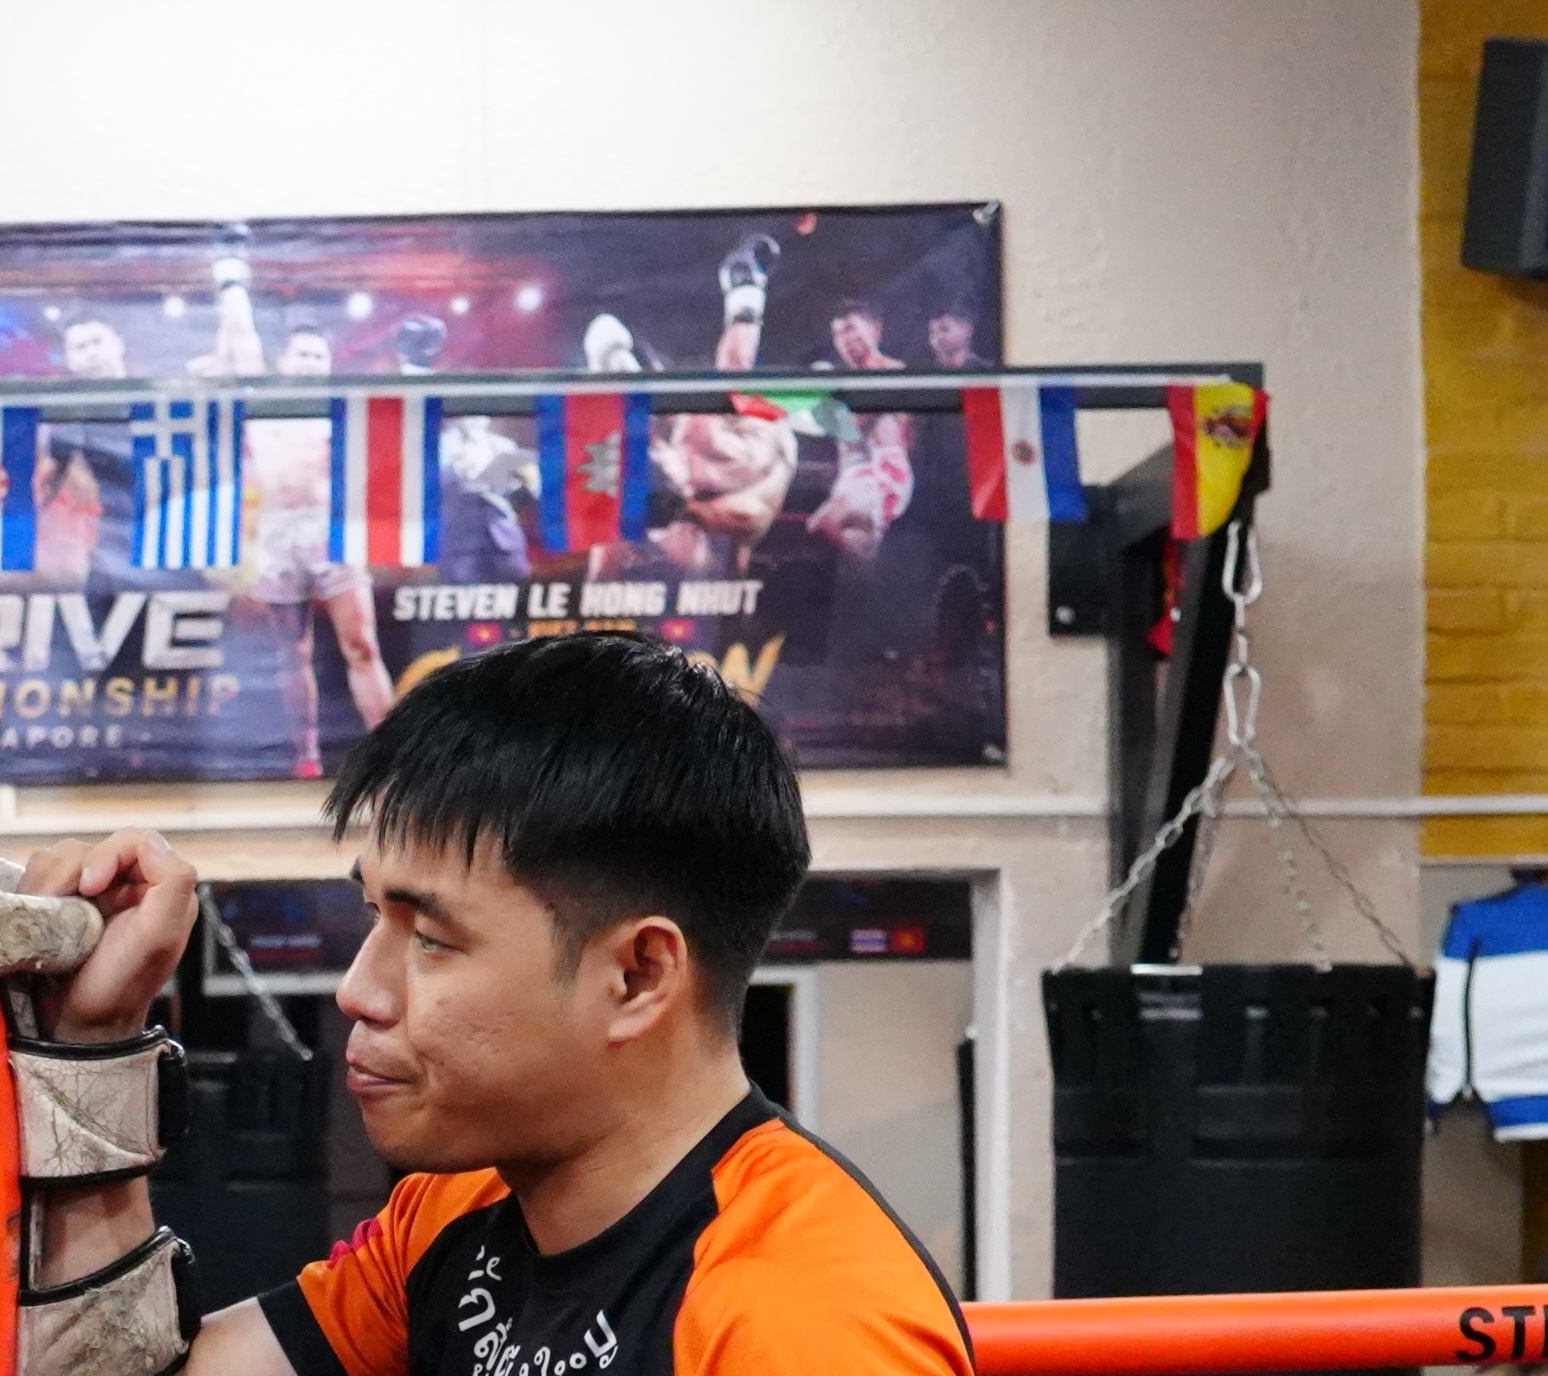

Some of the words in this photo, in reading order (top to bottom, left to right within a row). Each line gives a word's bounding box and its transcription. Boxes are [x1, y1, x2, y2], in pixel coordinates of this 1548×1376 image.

[393, 583, 519, 622] STEVEN
[527, 581, 572, 619] LE
[579, 580, 667, 618] HONG
[677, 579, 764, 616] NHUT
